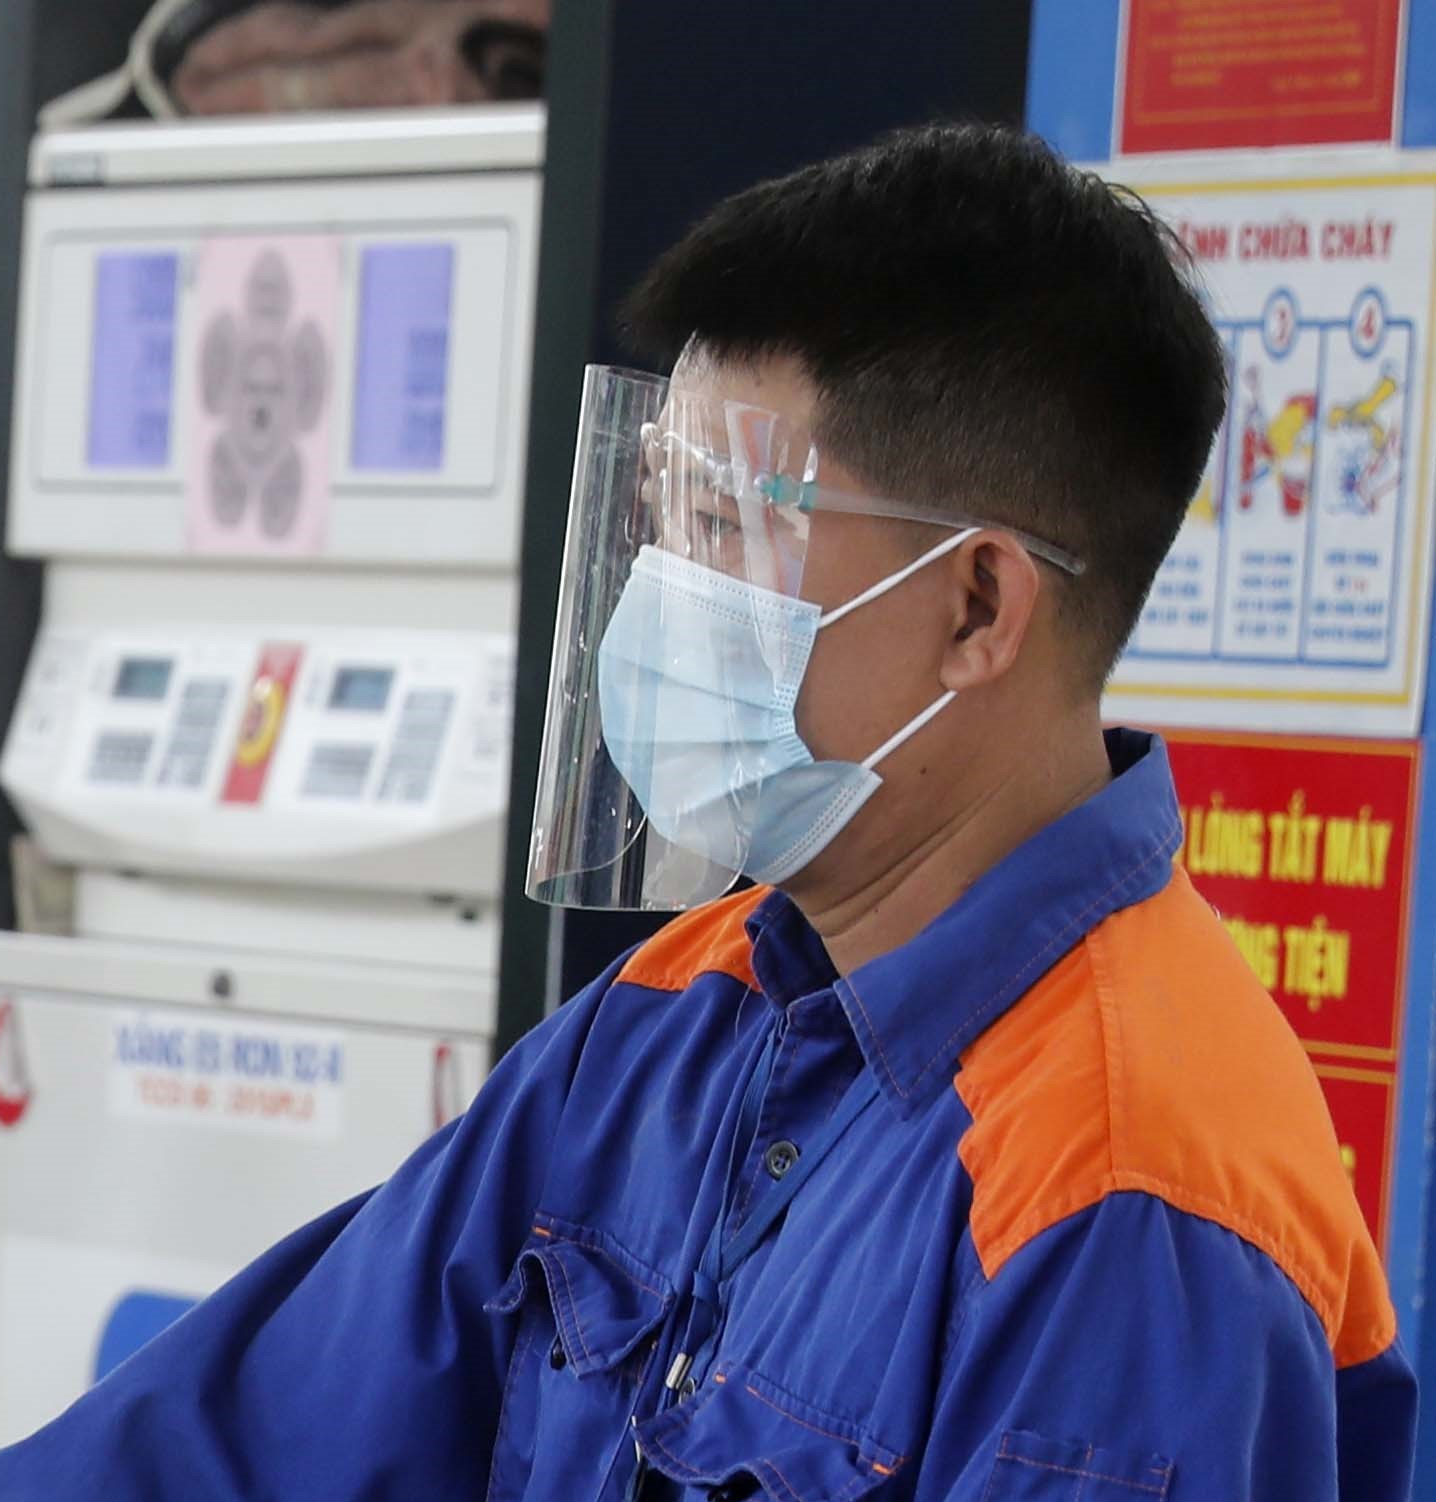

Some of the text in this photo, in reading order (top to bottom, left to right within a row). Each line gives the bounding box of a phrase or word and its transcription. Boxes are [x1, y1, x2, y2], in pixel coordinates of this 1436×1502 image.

[1321, 214, 1394, 259] CHÁY
[1323, 804, 1393, 890] MÁY
[1284, 914, 1351, 1013] TIỆN
